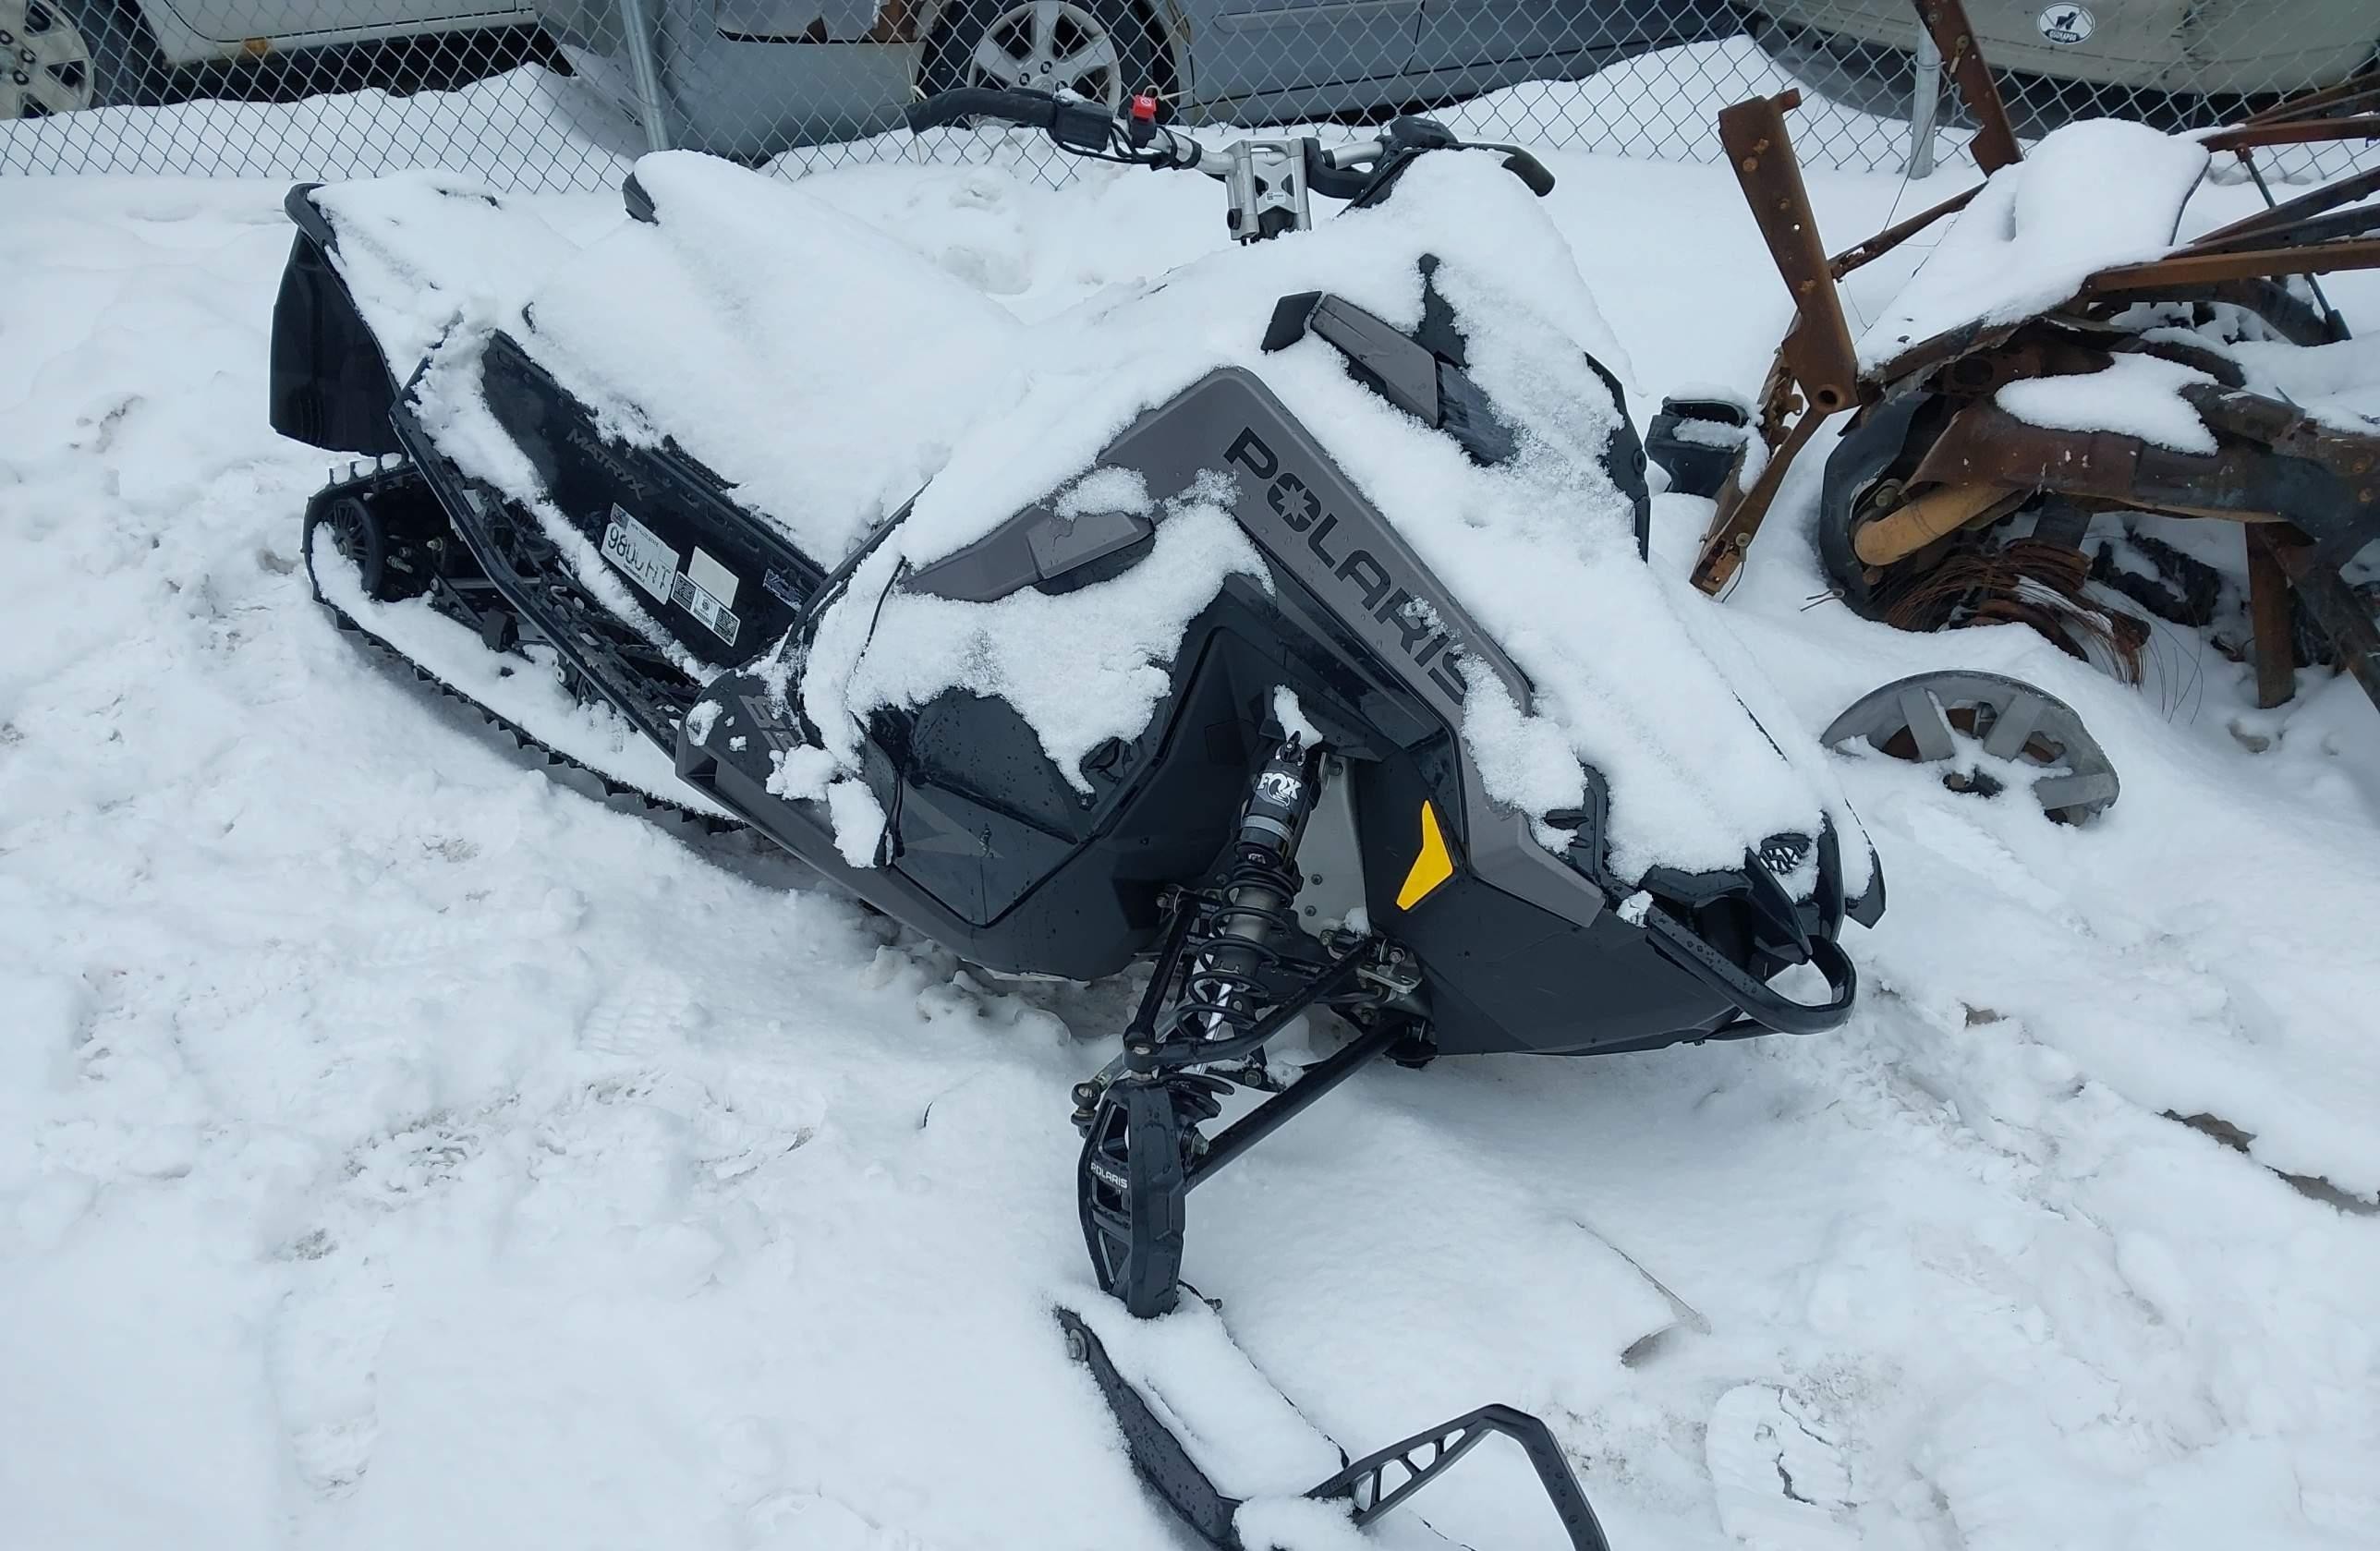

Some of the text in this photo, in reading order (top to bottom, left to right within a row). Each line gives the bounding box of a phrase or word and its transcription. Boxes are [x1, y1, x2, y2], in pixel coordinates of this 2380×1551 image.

[566, 428, 646, 502] MATRYX
[1223, 426, 1468, 706] POLARIS
[1257, 772, 1302, 807] FOX
[1090, 1161, 1128, 1189] POLARIS
